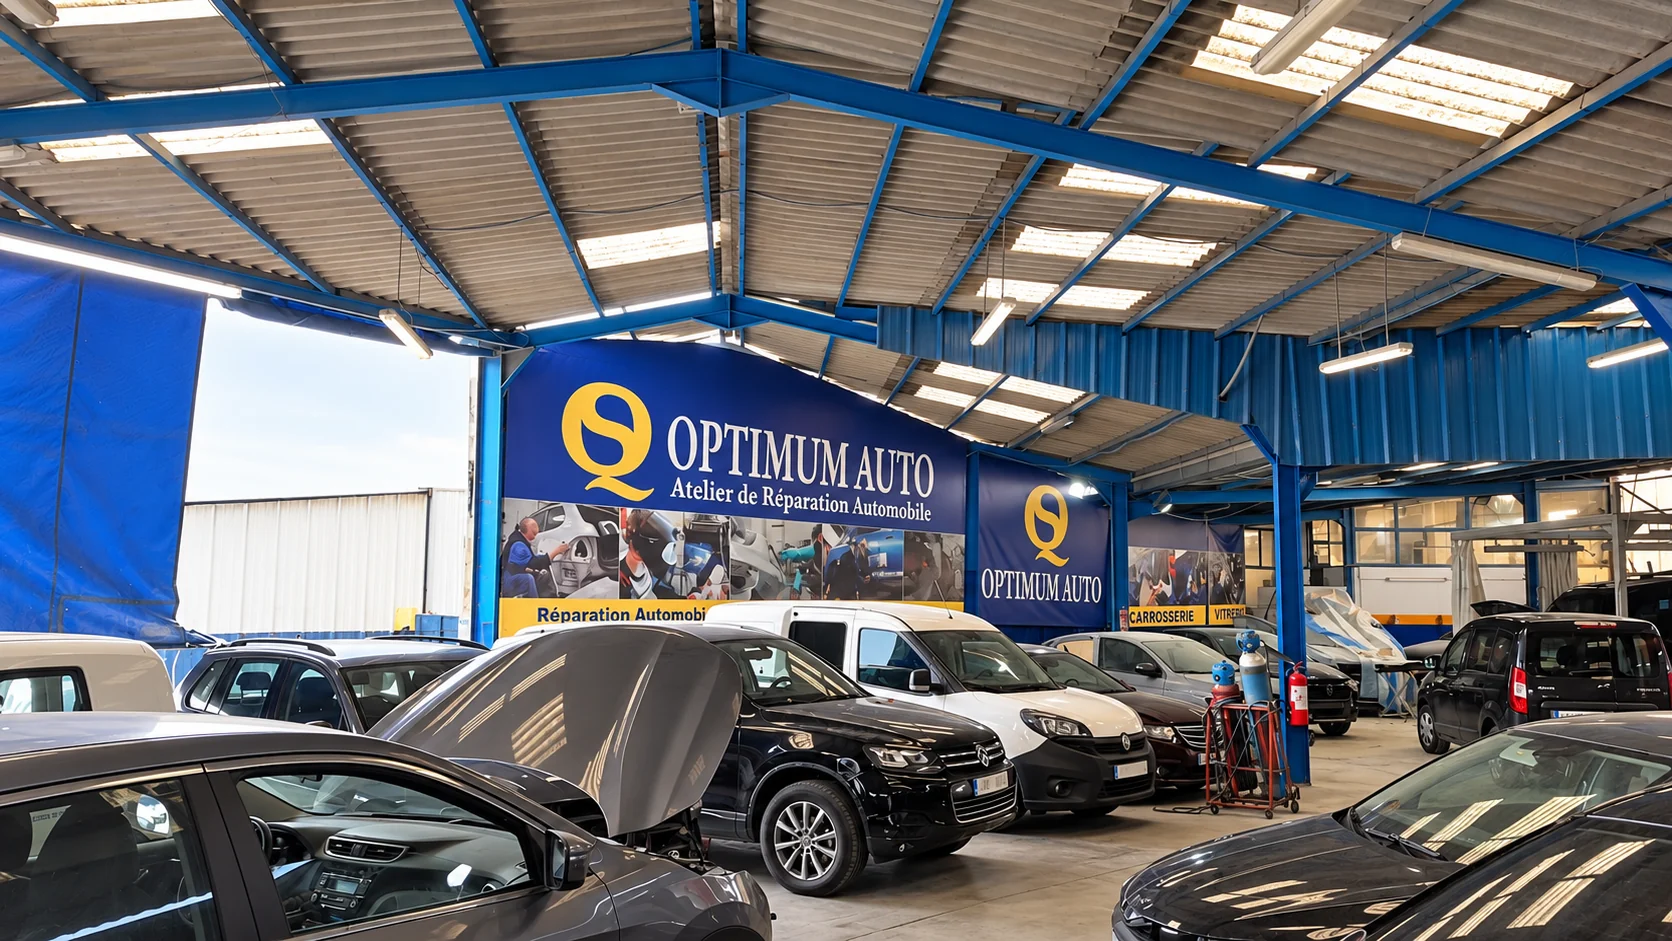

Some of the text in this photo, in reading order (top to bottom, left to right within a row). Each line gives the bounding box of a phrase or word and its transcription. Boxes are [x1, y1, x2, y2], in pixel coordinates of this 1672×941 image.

[667, 415, 935, 498] OPTIMUM AUTO
[669, 476, 932, 522] Atelier de Réparation Automobile
[981, 568, 1102, 604] OPTIMUM AUTO
[537, 606, 630, 623] Réparation
[1129, 610, 1194, 624] CARROSSERIE
